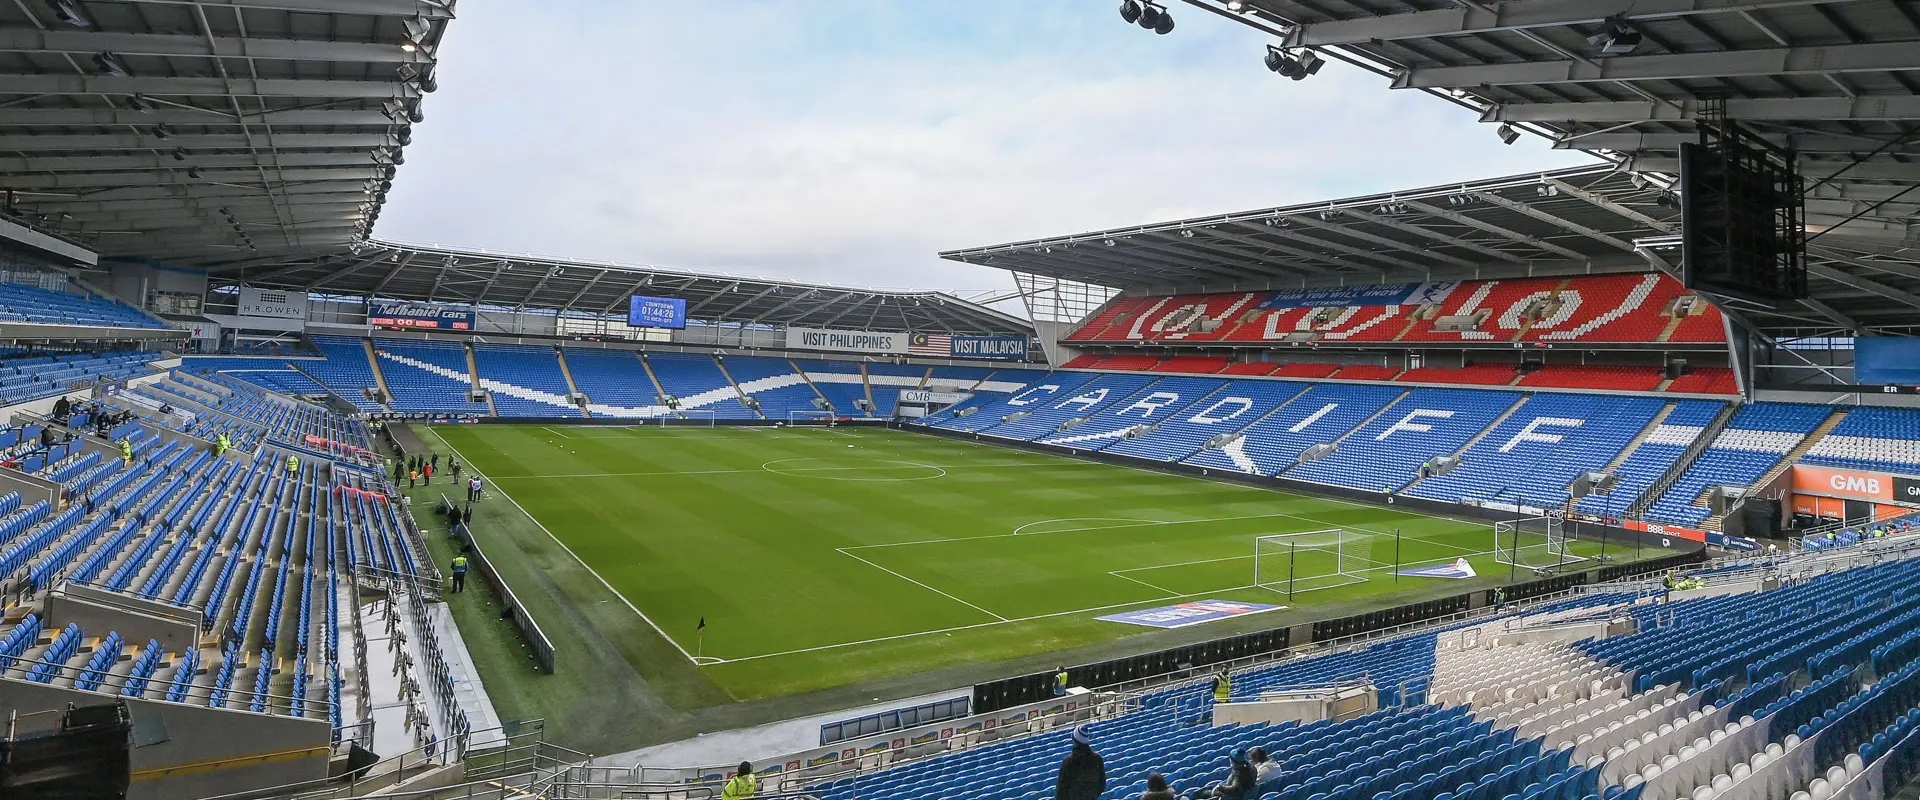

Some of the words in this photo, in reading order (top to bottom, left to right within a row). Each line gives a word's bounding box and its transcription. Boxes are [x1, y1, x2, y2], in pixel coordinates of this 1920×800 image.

[1275, 293, 1303, 301] THAN
[377, 303, 442, 318] Nathaniel
[442, 310, 468, 319] cars
[802, 331, 827, 347] VISIT
[829, 333, 892, 350] PHILIPPINES
[954, 339, 979, 354] VISIT
[980, 340, 1024, 355] MALAYSIA
[906, 391, 930, 401] CMB
[1008, 385, 1584, 453] CARDIFF
[1830, 474, 1880, 494] GMB
[1647, 524, 1681, 537] 888sport
